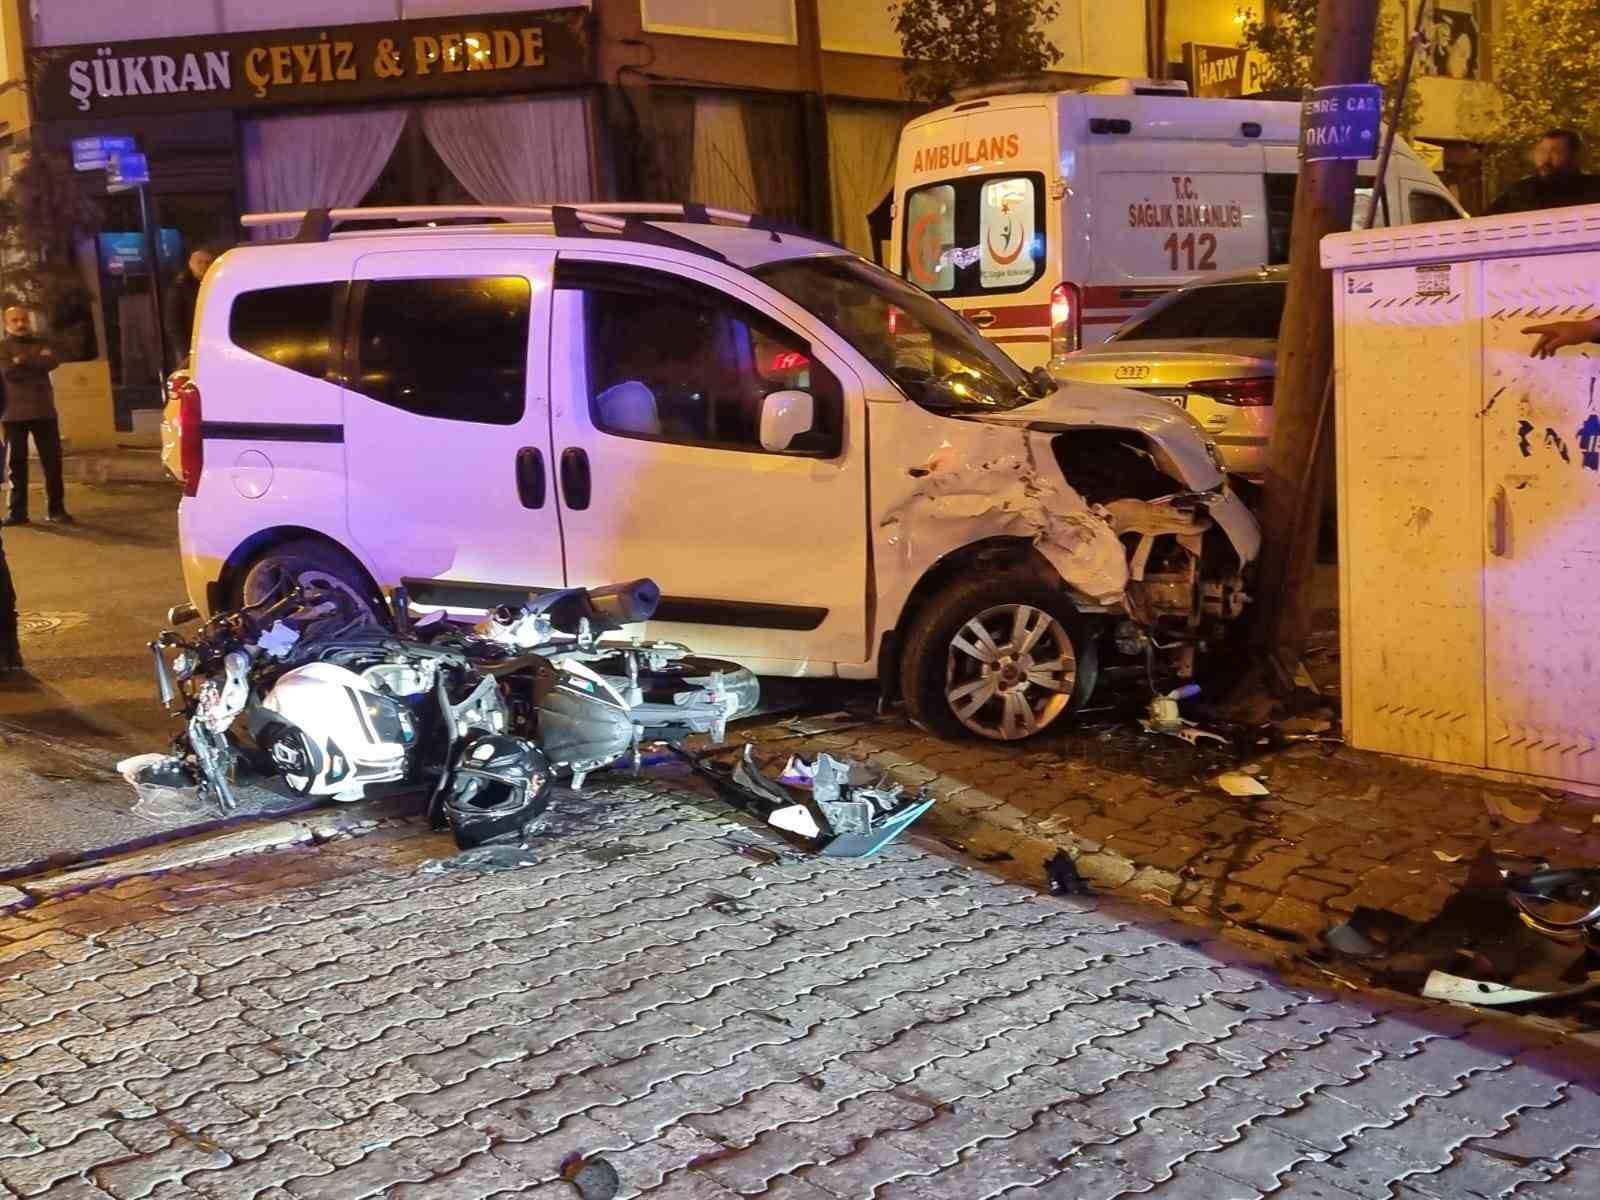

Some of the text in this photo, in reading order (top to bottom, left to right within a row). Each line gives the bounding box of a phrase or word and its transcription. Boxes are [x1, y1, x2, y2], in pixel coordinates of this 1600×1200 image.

[69, 27, 546, 111] ŞÜKRAN ÇEYİZ & PERDE
[1200, 55, 1239, 87] HATAY
[1303, 125, 1352, 146] OKAK
[913, 134, 1020, 174] AMBULANS
[1171, 176, 1199, 200] T.C.
[1128, 197, 1175, 228] SAĞLIK
[1164, 232, 1217, 271] 112
